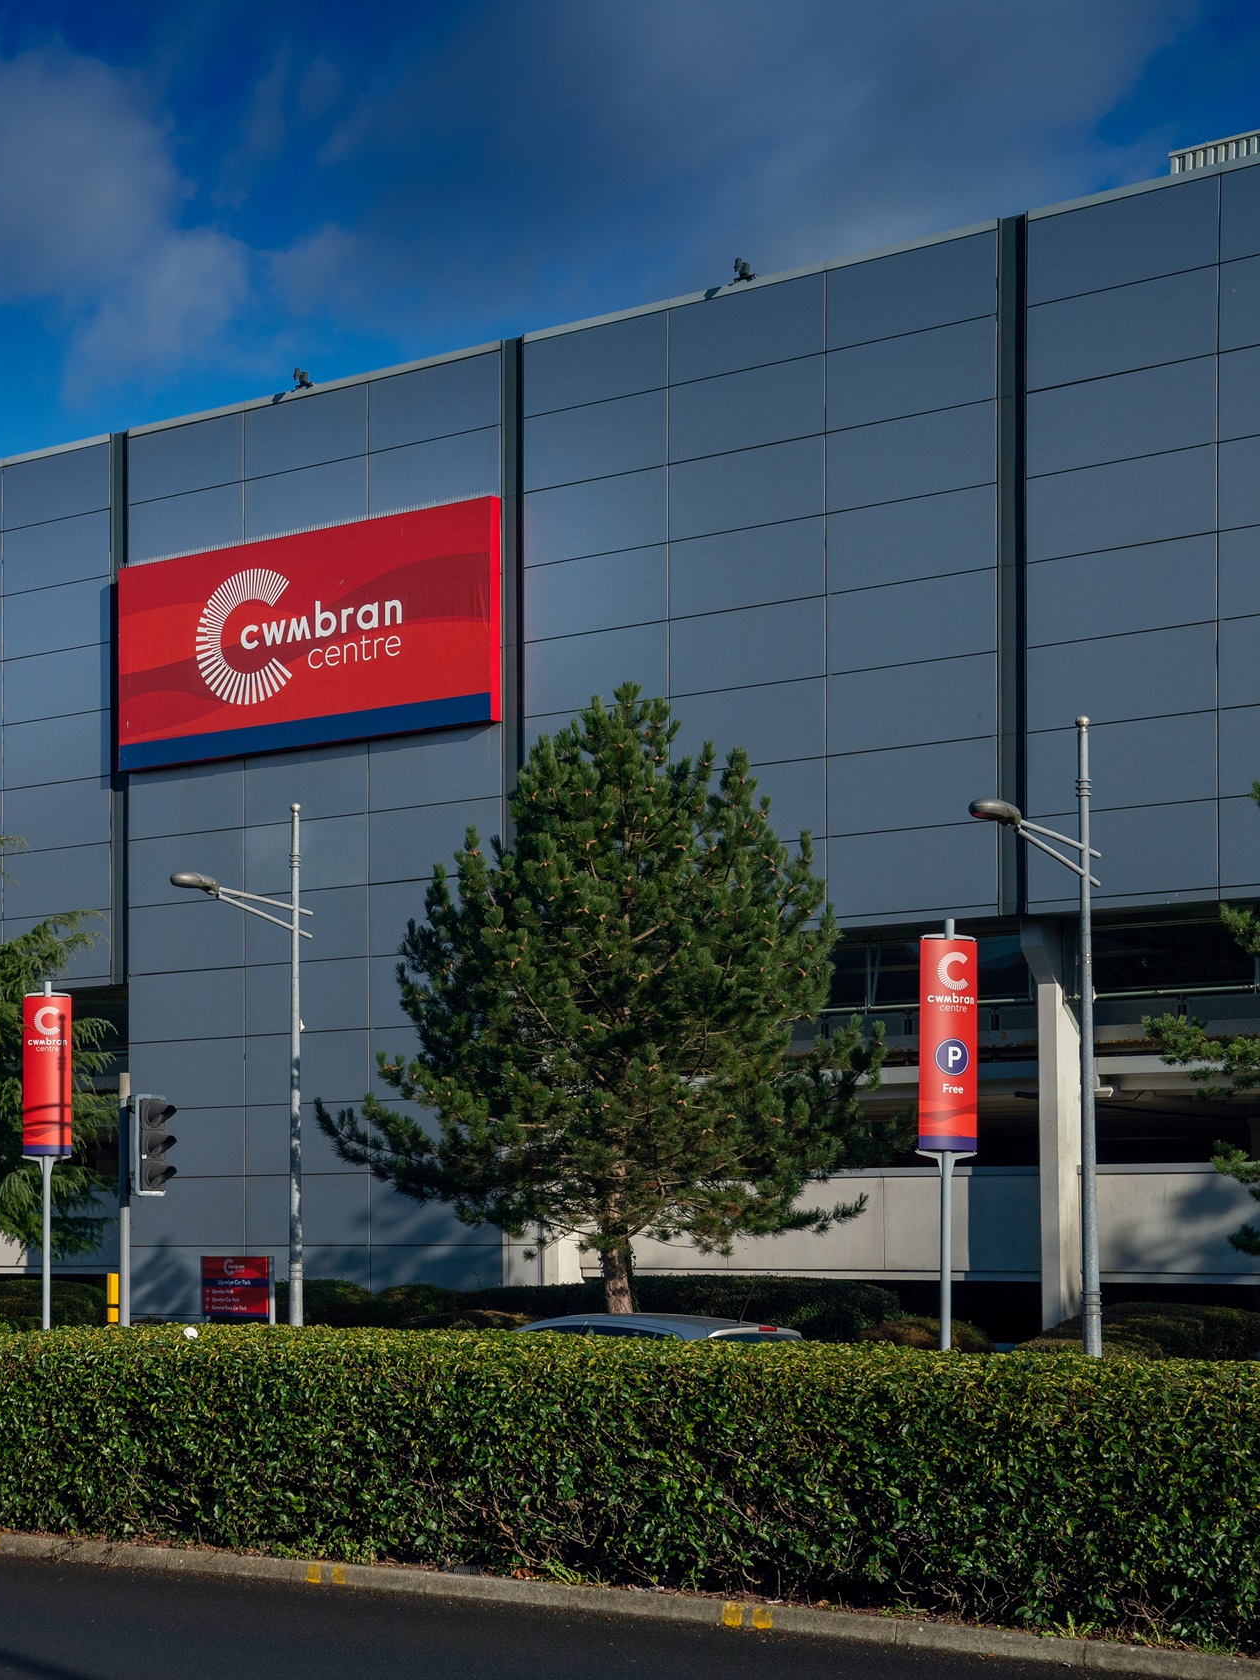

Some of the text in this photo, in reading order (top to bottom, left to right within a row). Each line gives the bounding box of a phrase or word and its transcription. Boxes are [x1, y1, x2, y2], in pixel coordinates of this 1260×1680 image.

[240, 598, 402, 650] cwmbran
[307, 635, 401, 669] centre
[927, 992, 974, 1005] cwmbran
[939, 1004, 967, 1013] centre
[27, 1037, 68, 1046] cwmbran
[942, 1084, 964, 1093] Free
